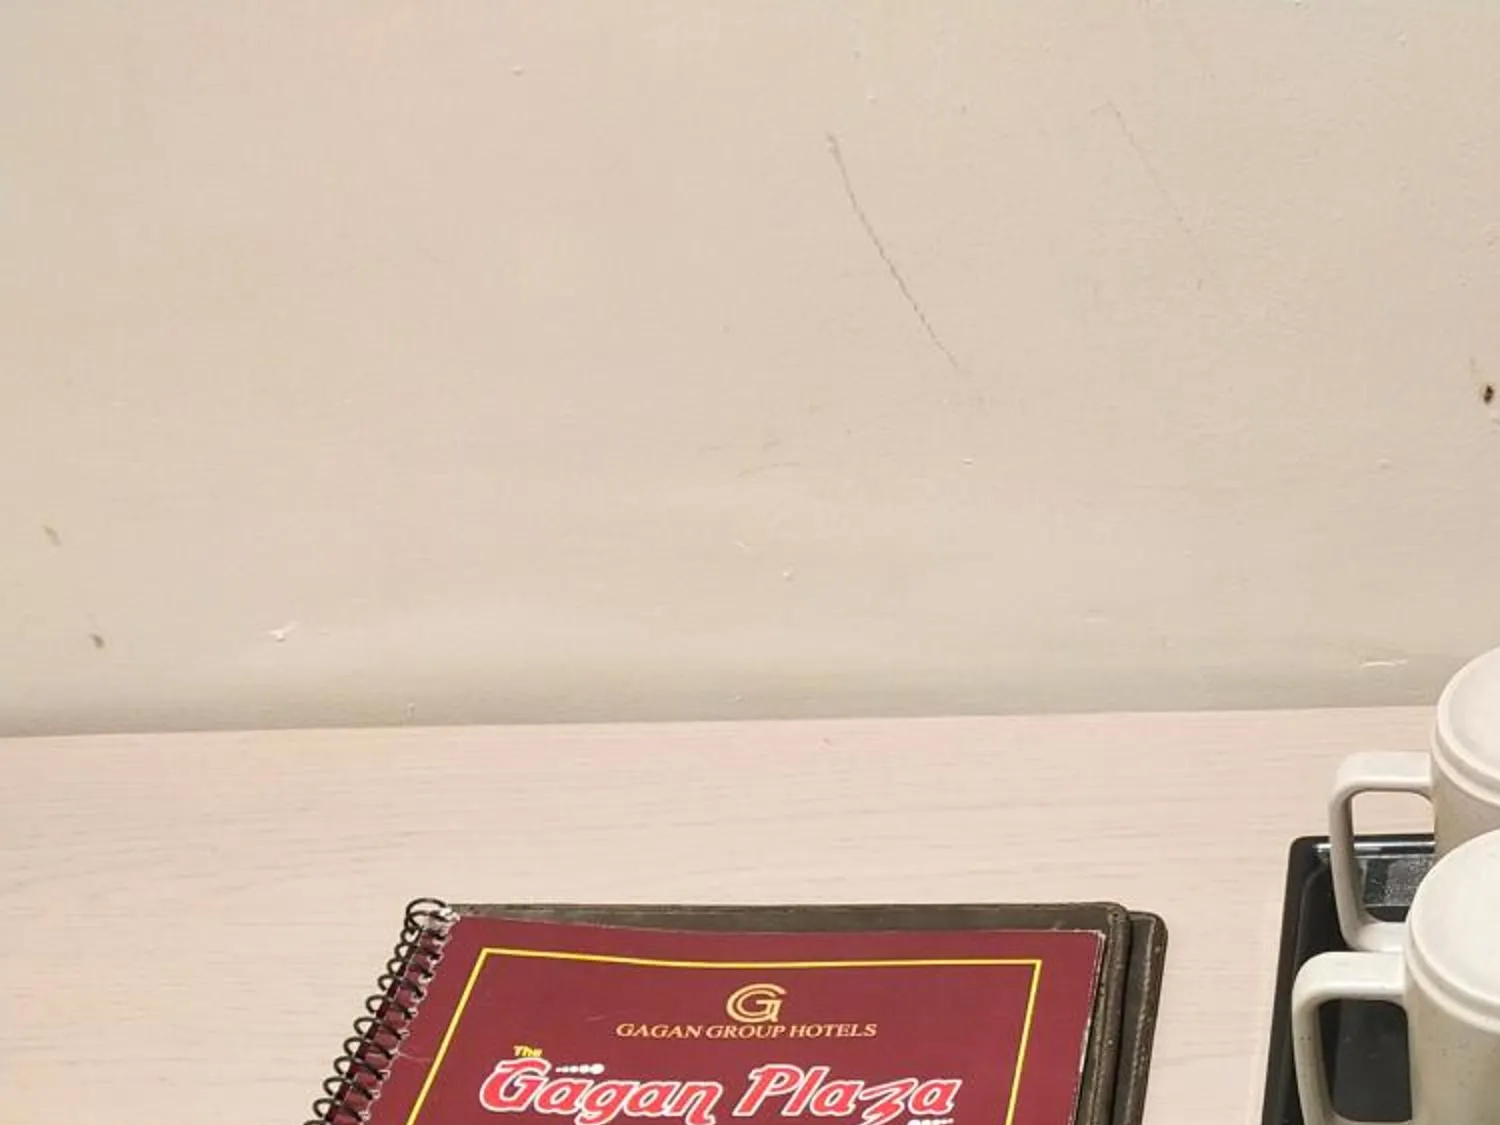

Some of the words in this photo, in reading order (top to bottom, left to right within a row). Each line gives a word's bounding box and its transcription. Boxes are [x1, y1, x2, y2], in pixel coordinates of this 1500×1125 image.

[615, 1023, 703, 1039] GAGAN
[705, 1024, 787, 1039] GROUP
[788, 1023, 878, 1038] HOTELS
[513, 1044, 543, 1058] The
